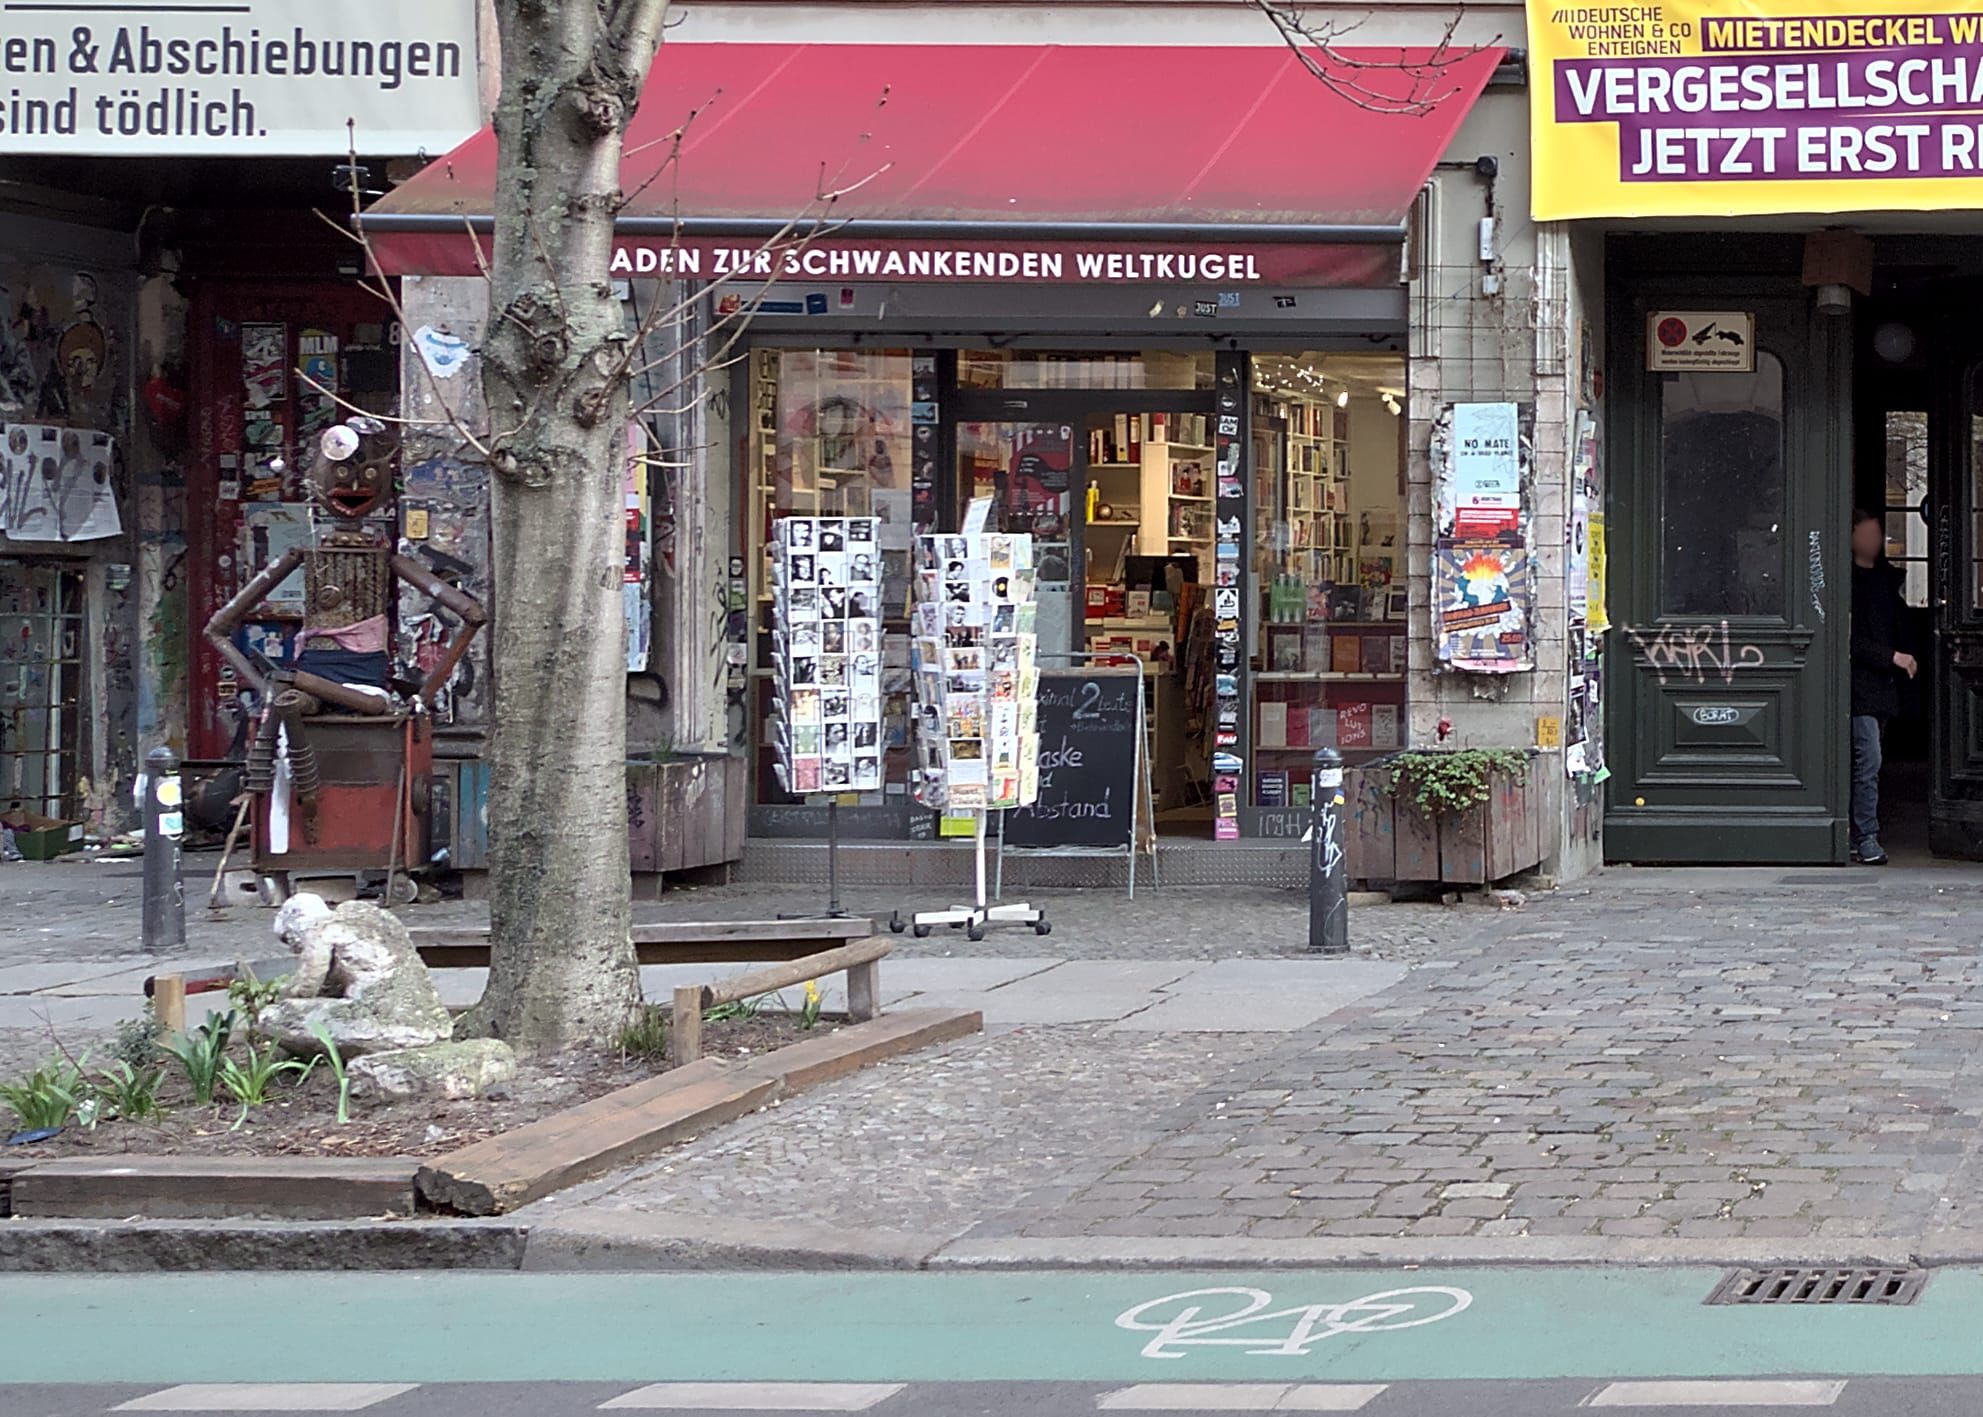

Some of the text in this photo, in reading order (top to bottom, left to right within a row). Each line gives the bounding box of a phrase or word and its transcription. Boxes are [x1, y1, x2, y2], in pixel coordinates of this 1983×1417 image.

[1569, 22, 1692, 39] WOHNEN & CO
[1708, 16, 1983, 48] MIETENDECKEL W
[0, 26, 461, 90] en & Abschiebungen
[1588, 40, 1681, 55] ENTEIGNEN
[95, 88, 267, 137] tödlich.
[1632, 124, 1983, 175] JETZT ERST R
[609, 247, 1261, 279] ADEN ZUR SCHWANKENDEN WELTKUGEL
[1194, 301, 1217, 314] JUST
[1464, 438, 1510, 449] NO MATE
[1072, 681, 1101, 720] 2
[1038, 735, 1083, 769] aske
